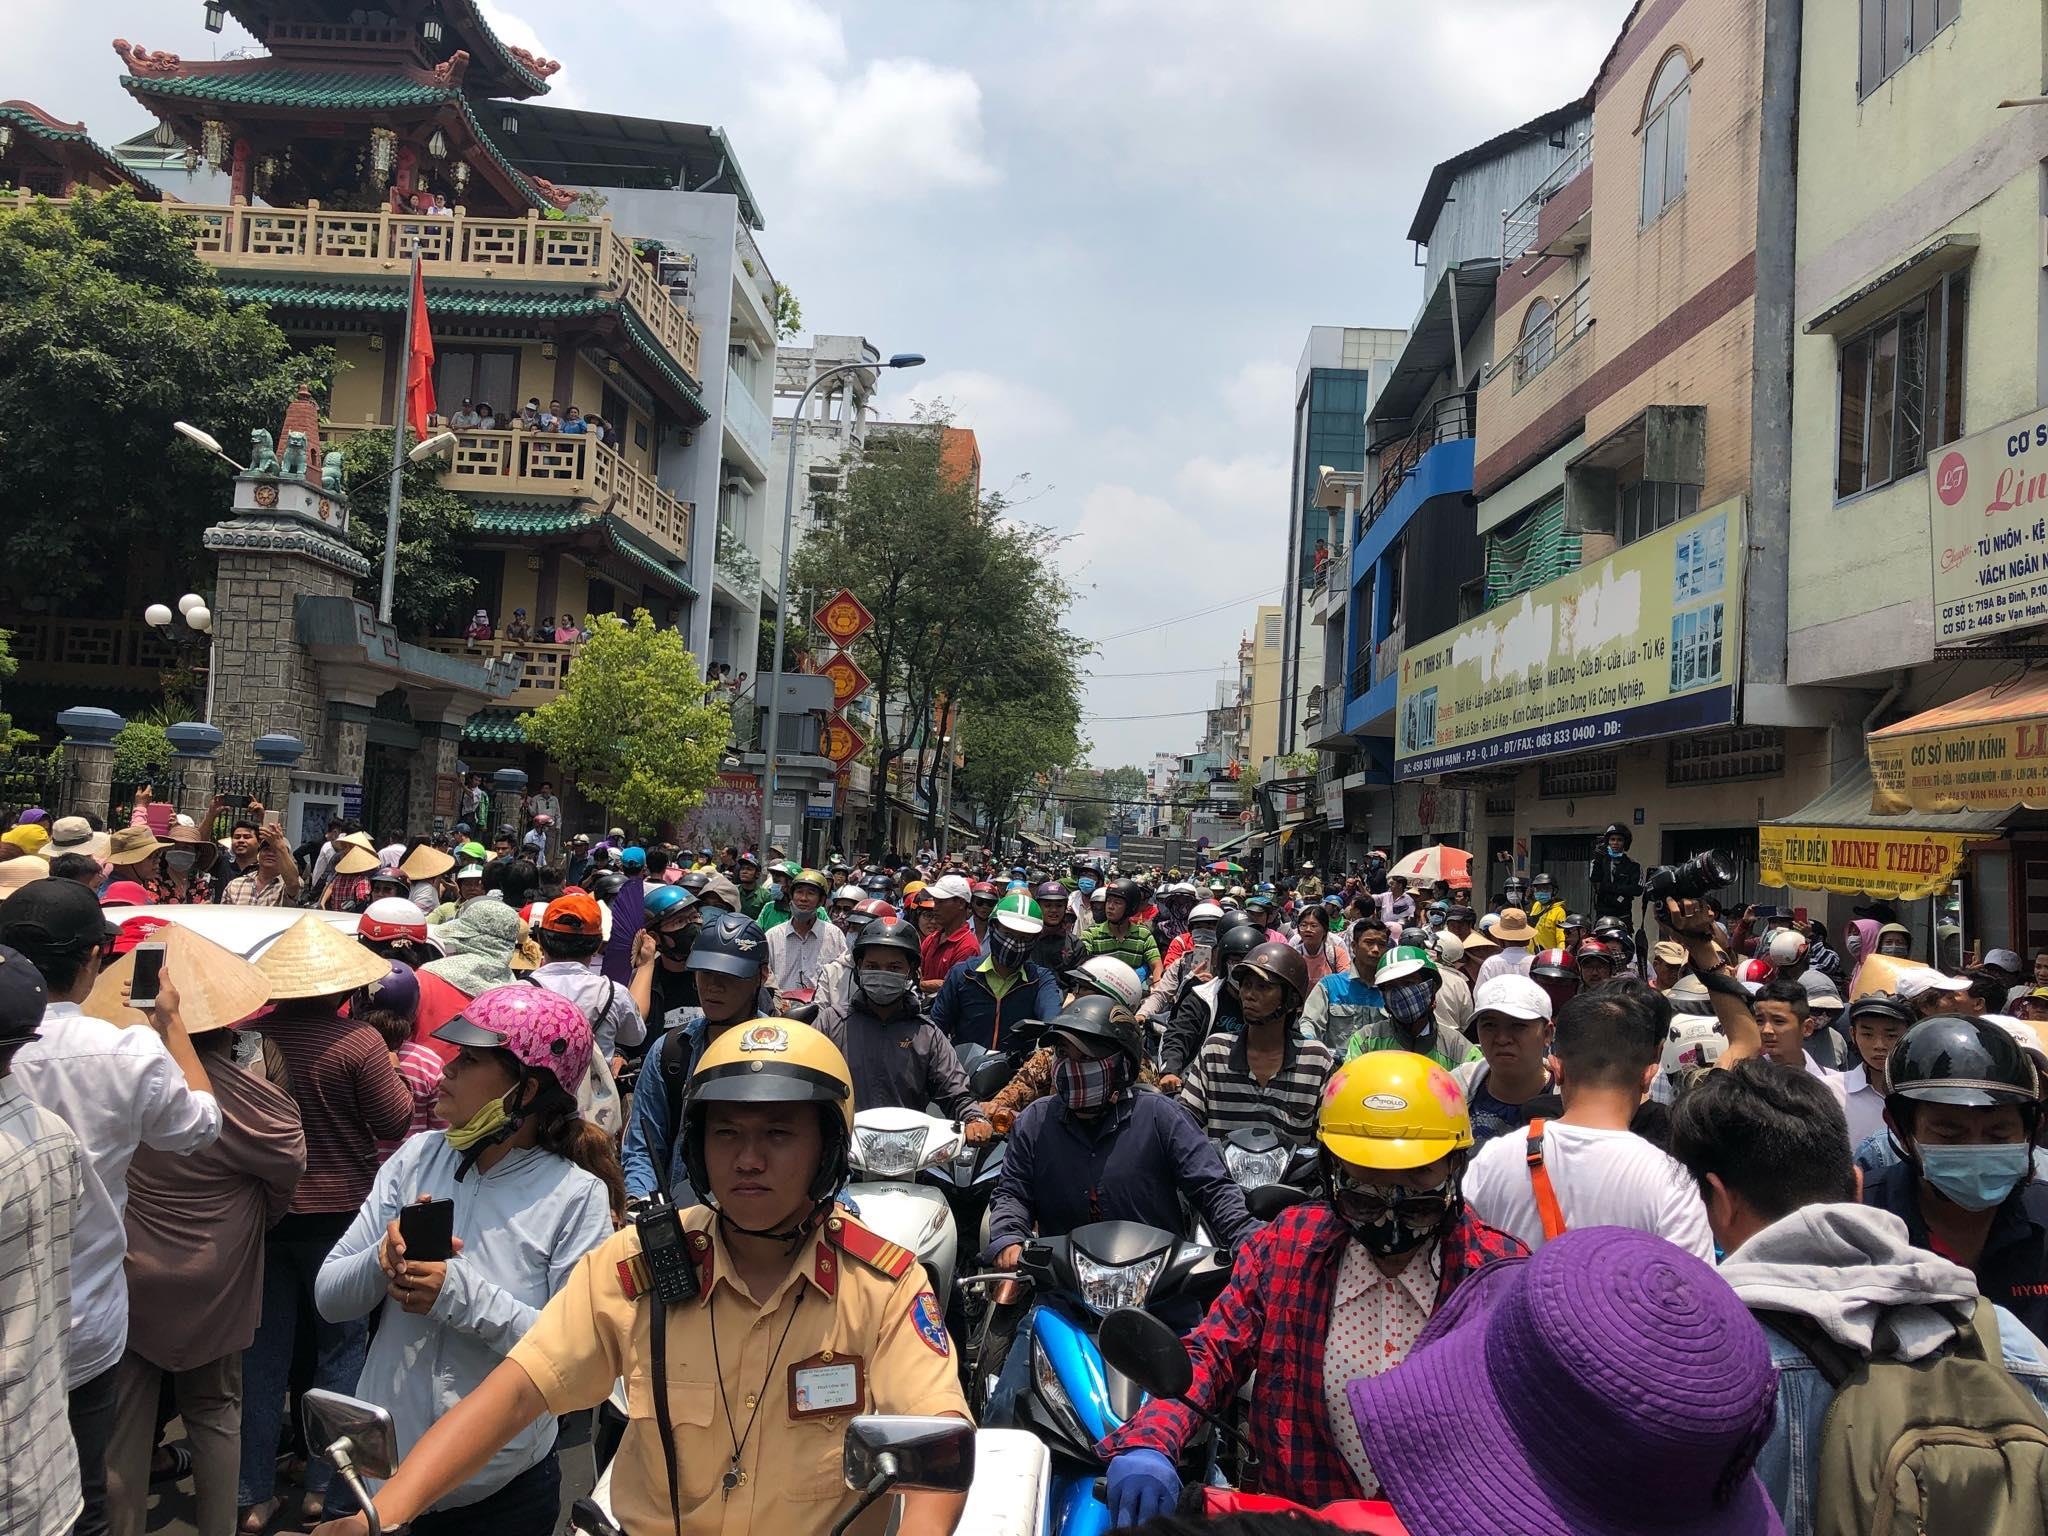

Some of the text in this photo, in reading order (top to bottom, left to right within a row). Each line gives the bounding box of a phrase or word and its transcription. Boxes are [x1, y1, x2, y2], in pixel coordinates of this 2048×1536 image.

[2008, 430, 2030, 457] CƠ
[1993, 527, 2022, 552] NHÔM
[2032, 517, 2046, 544] KỆ
[1979, 564, 2006, 586] VÁCH
[2009, 553, 2039, 578] NGĂN
[1976, 598, 1994, 611] 719A
[1996, 595, 2006, 606] Ba
[1977, 614, 1993, 626] 448
[1655, 636, 1665, 660] Kệ
[1490, 743, 1499, 757] 10
[1536, 733, 1552, 748] 083
[1553, 729, 1570, 744] 833
[1573, 725, 1595, 741] 0400
[1945, 736, 1975, 763] NHÔM
[1978, 733, 2006, 760] KÍNH
[1831, 839, 1880, 870] MINH
[1885, 836, 1950, 881] THIỆP
